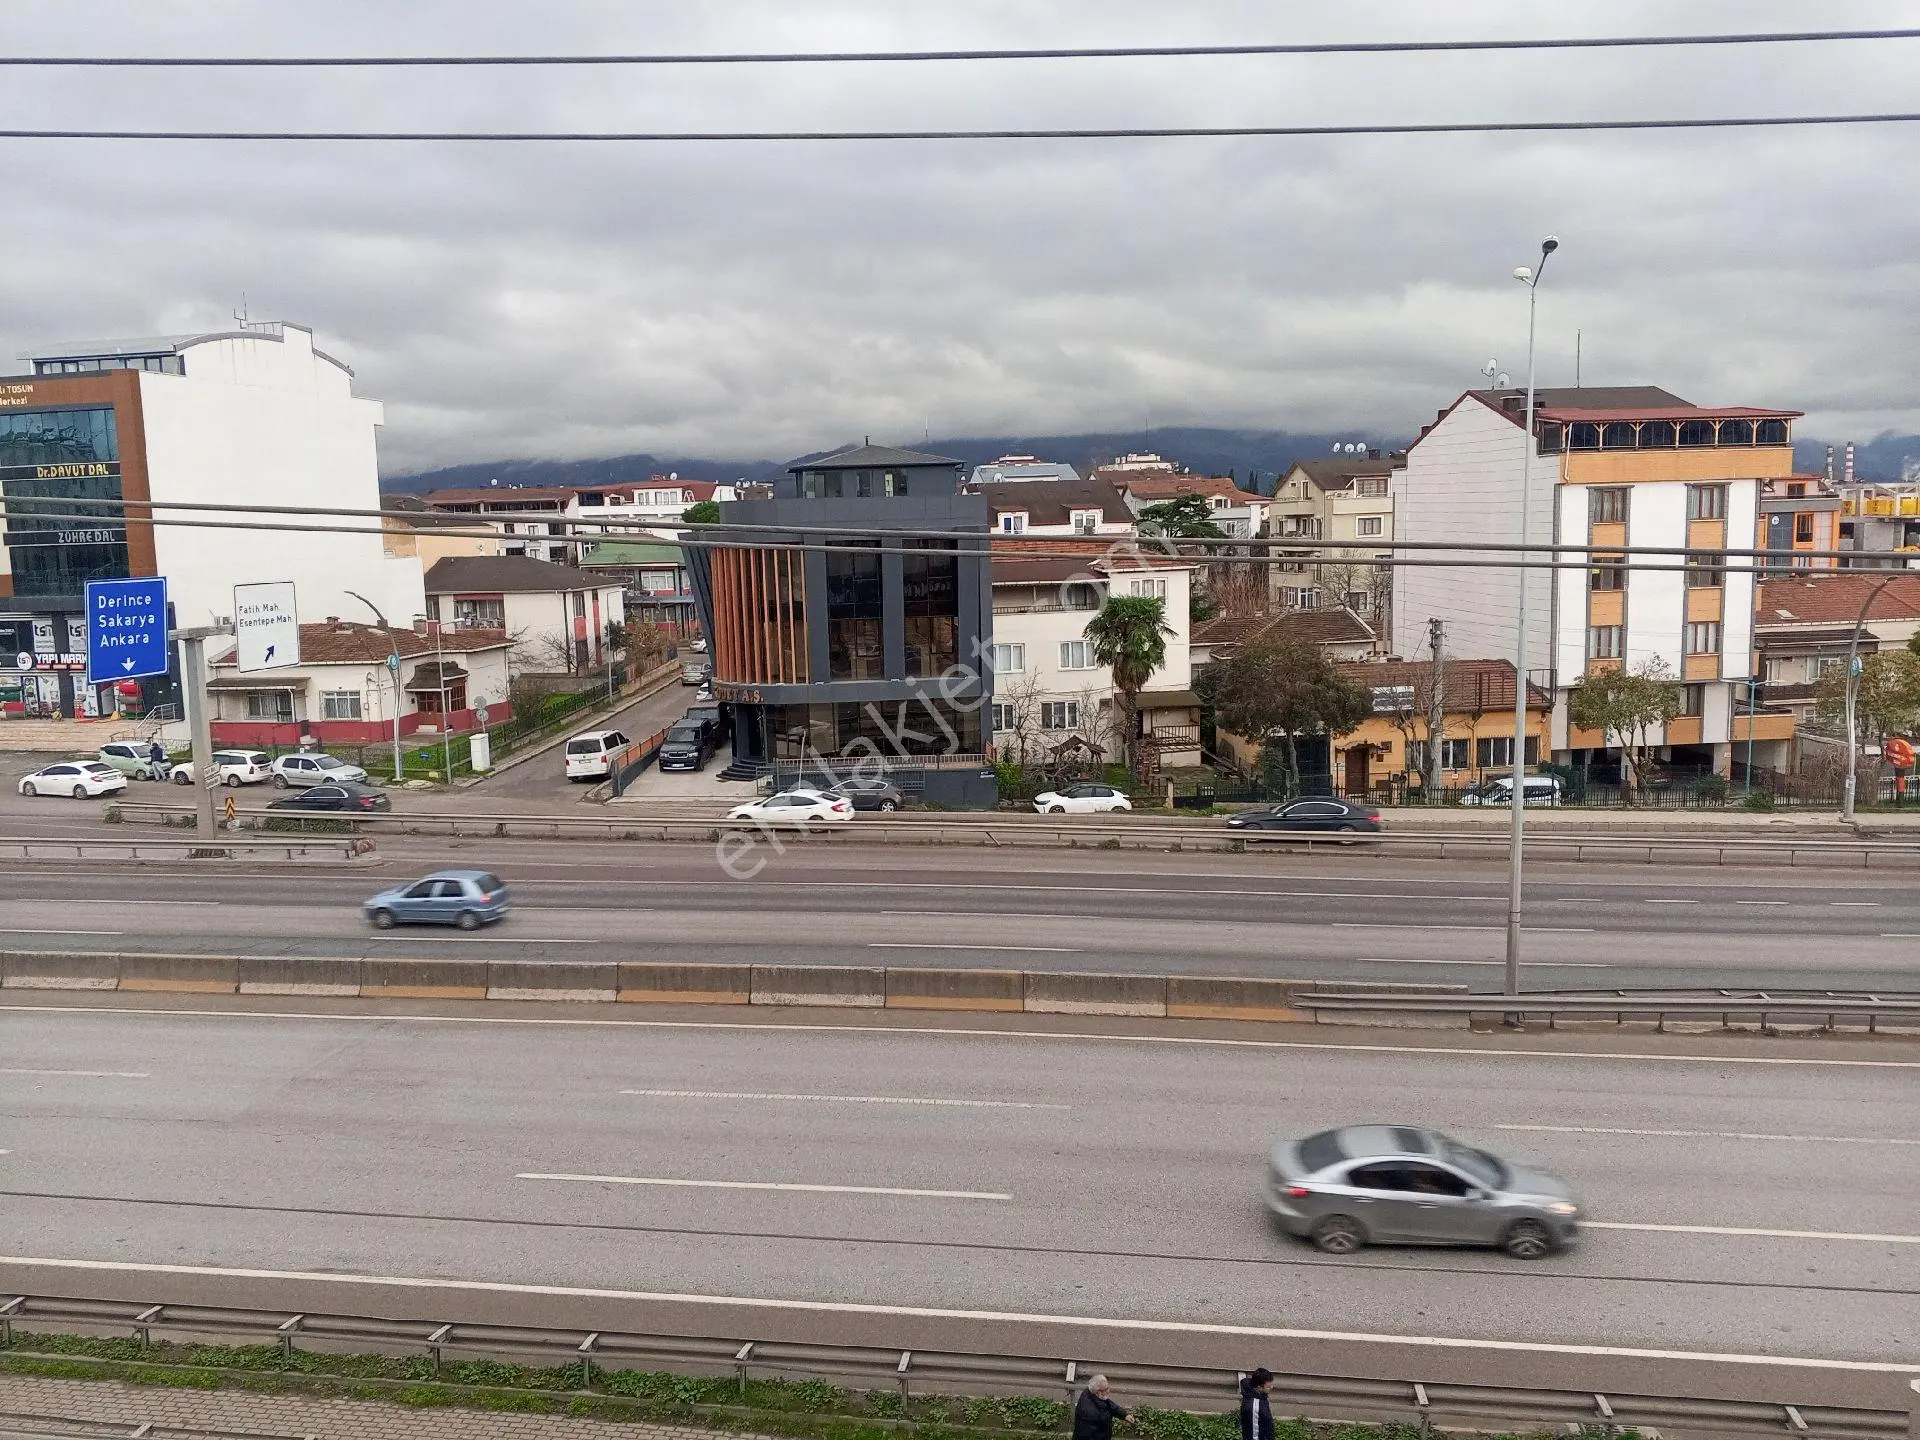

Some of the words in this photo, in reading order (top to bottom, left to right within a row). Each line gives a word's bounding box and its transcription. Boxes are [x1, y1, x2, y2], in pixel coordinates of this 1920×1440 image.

[8, 385, 34, 394] TOSUN
[37, 465, 86, 478] Dr.DAVUT
[88, 464, 109, 475] DAL
[94, 530, 116, 542] DAL
[98, 594, 152, 609] Derince
[239, 605, 260, 614] Fatih
[99, 613, 156, 628] Sakarya
[239, 617, 275, 628] Esentepe
[100, 633, 150, 647] Ankara
[35, 653, 58, 664] YAPI
